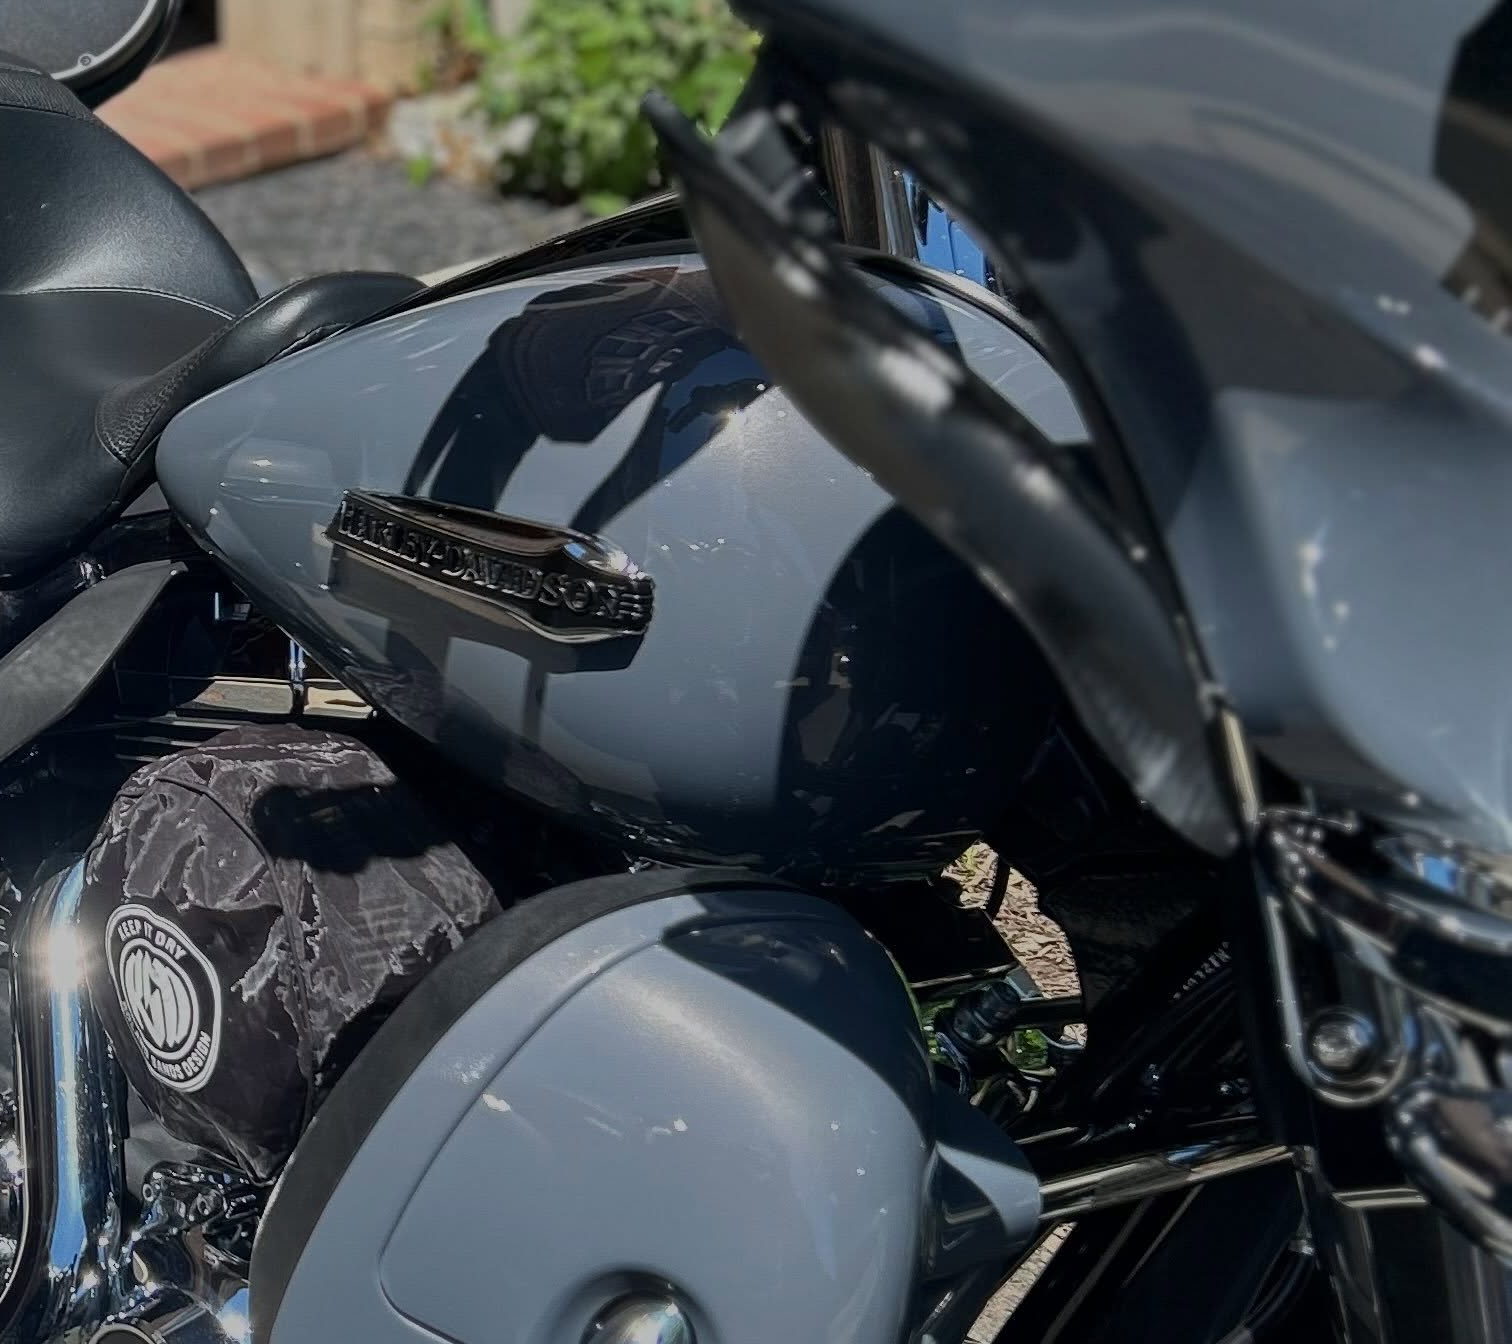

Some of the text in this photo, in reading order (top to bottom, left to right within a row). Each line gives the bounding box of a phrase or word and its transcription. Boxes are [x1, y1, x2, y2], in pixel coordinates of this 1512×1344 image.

[117, 919, 187, 960] KEEP IT DRY
[183, 1030, 211, 1077] DESIGN
